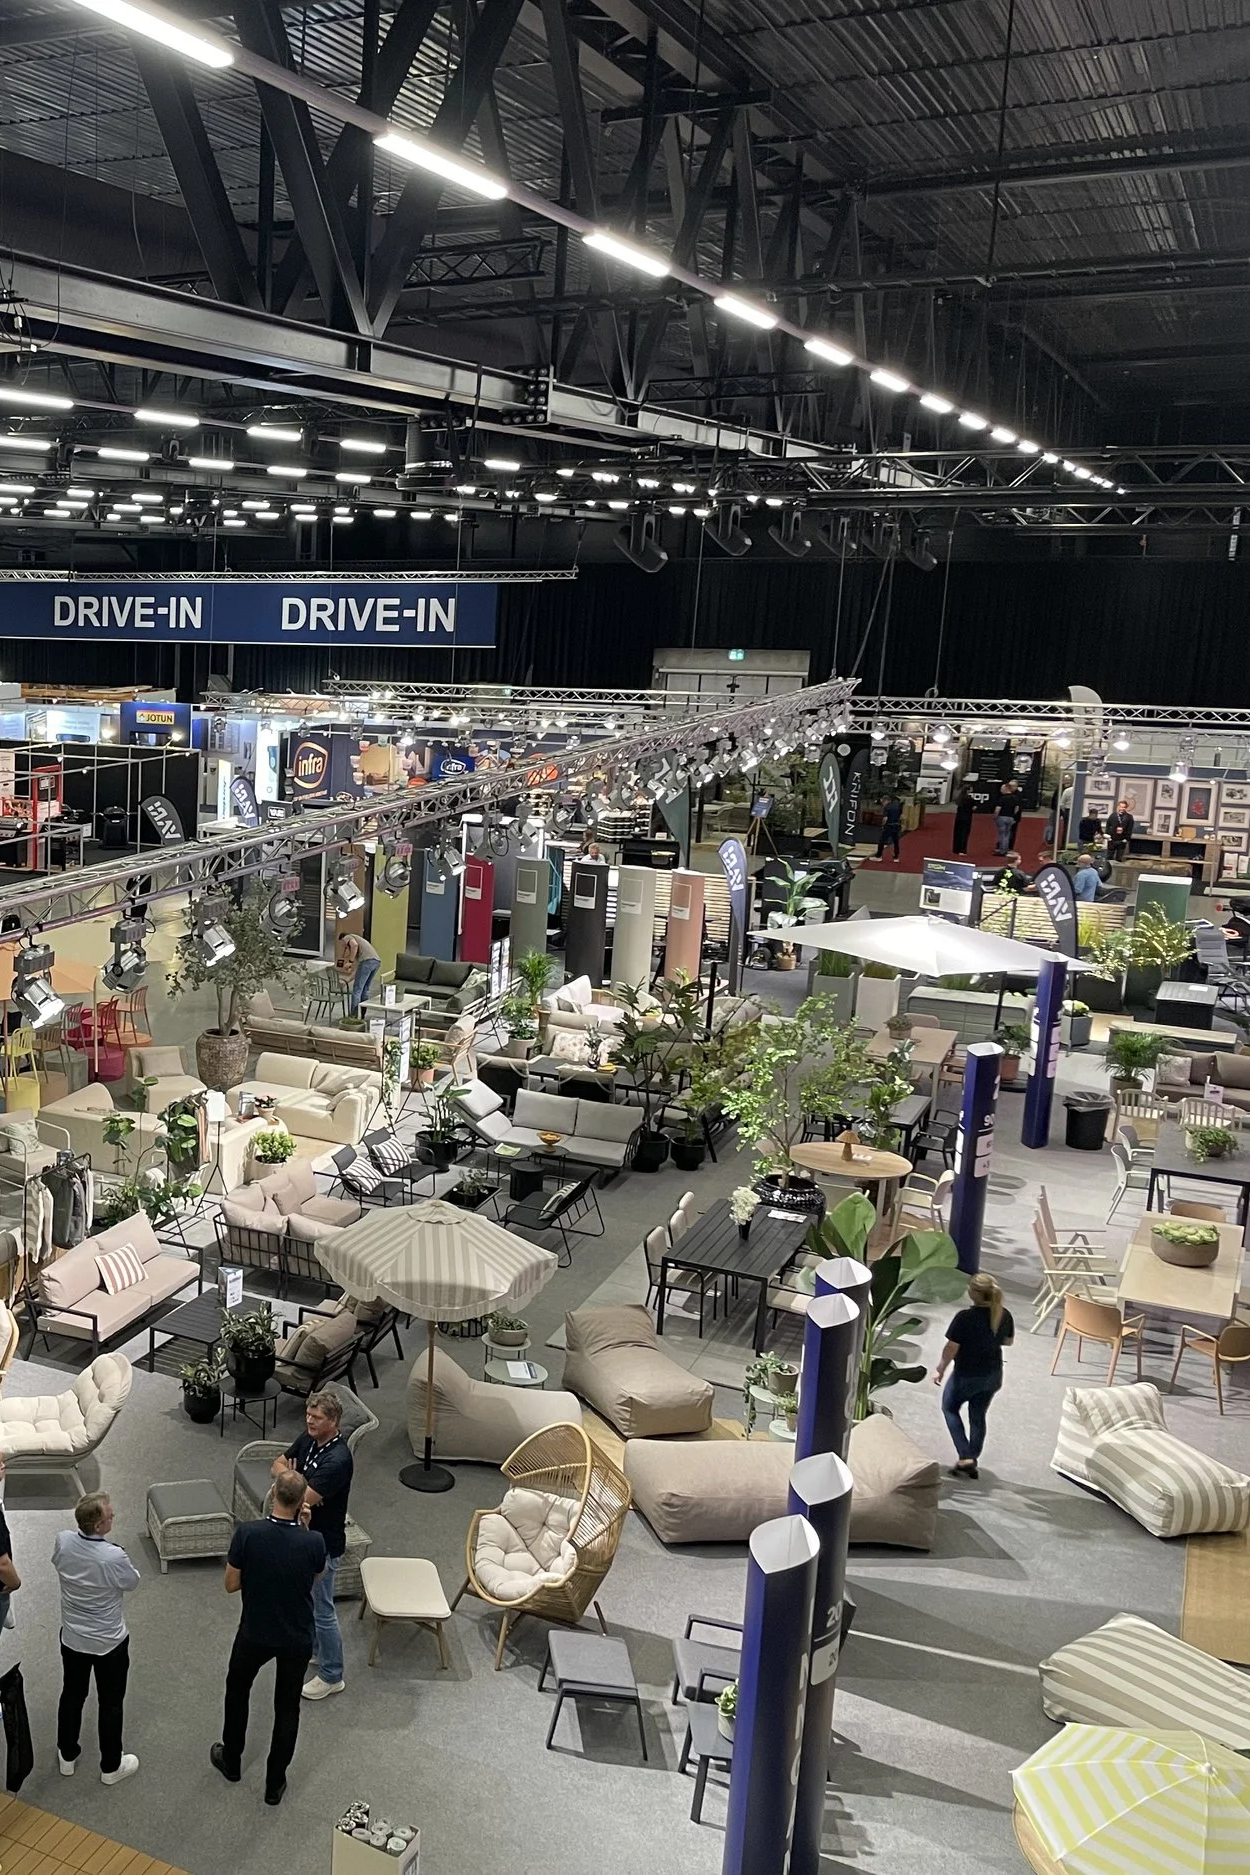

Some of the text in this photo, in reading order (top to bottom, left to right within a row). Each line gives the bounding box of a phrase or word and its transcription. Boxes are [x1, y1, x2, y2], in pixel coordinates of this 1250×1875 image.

[53, 595, 203, 629] DRIVE-IN
[281, 597, 456, 632] DRIVE-IN
[146, 714, 173, 723] JOTUN
[298, 753, 323, 777] infra
[826, 1600, 843, 1629] 20
